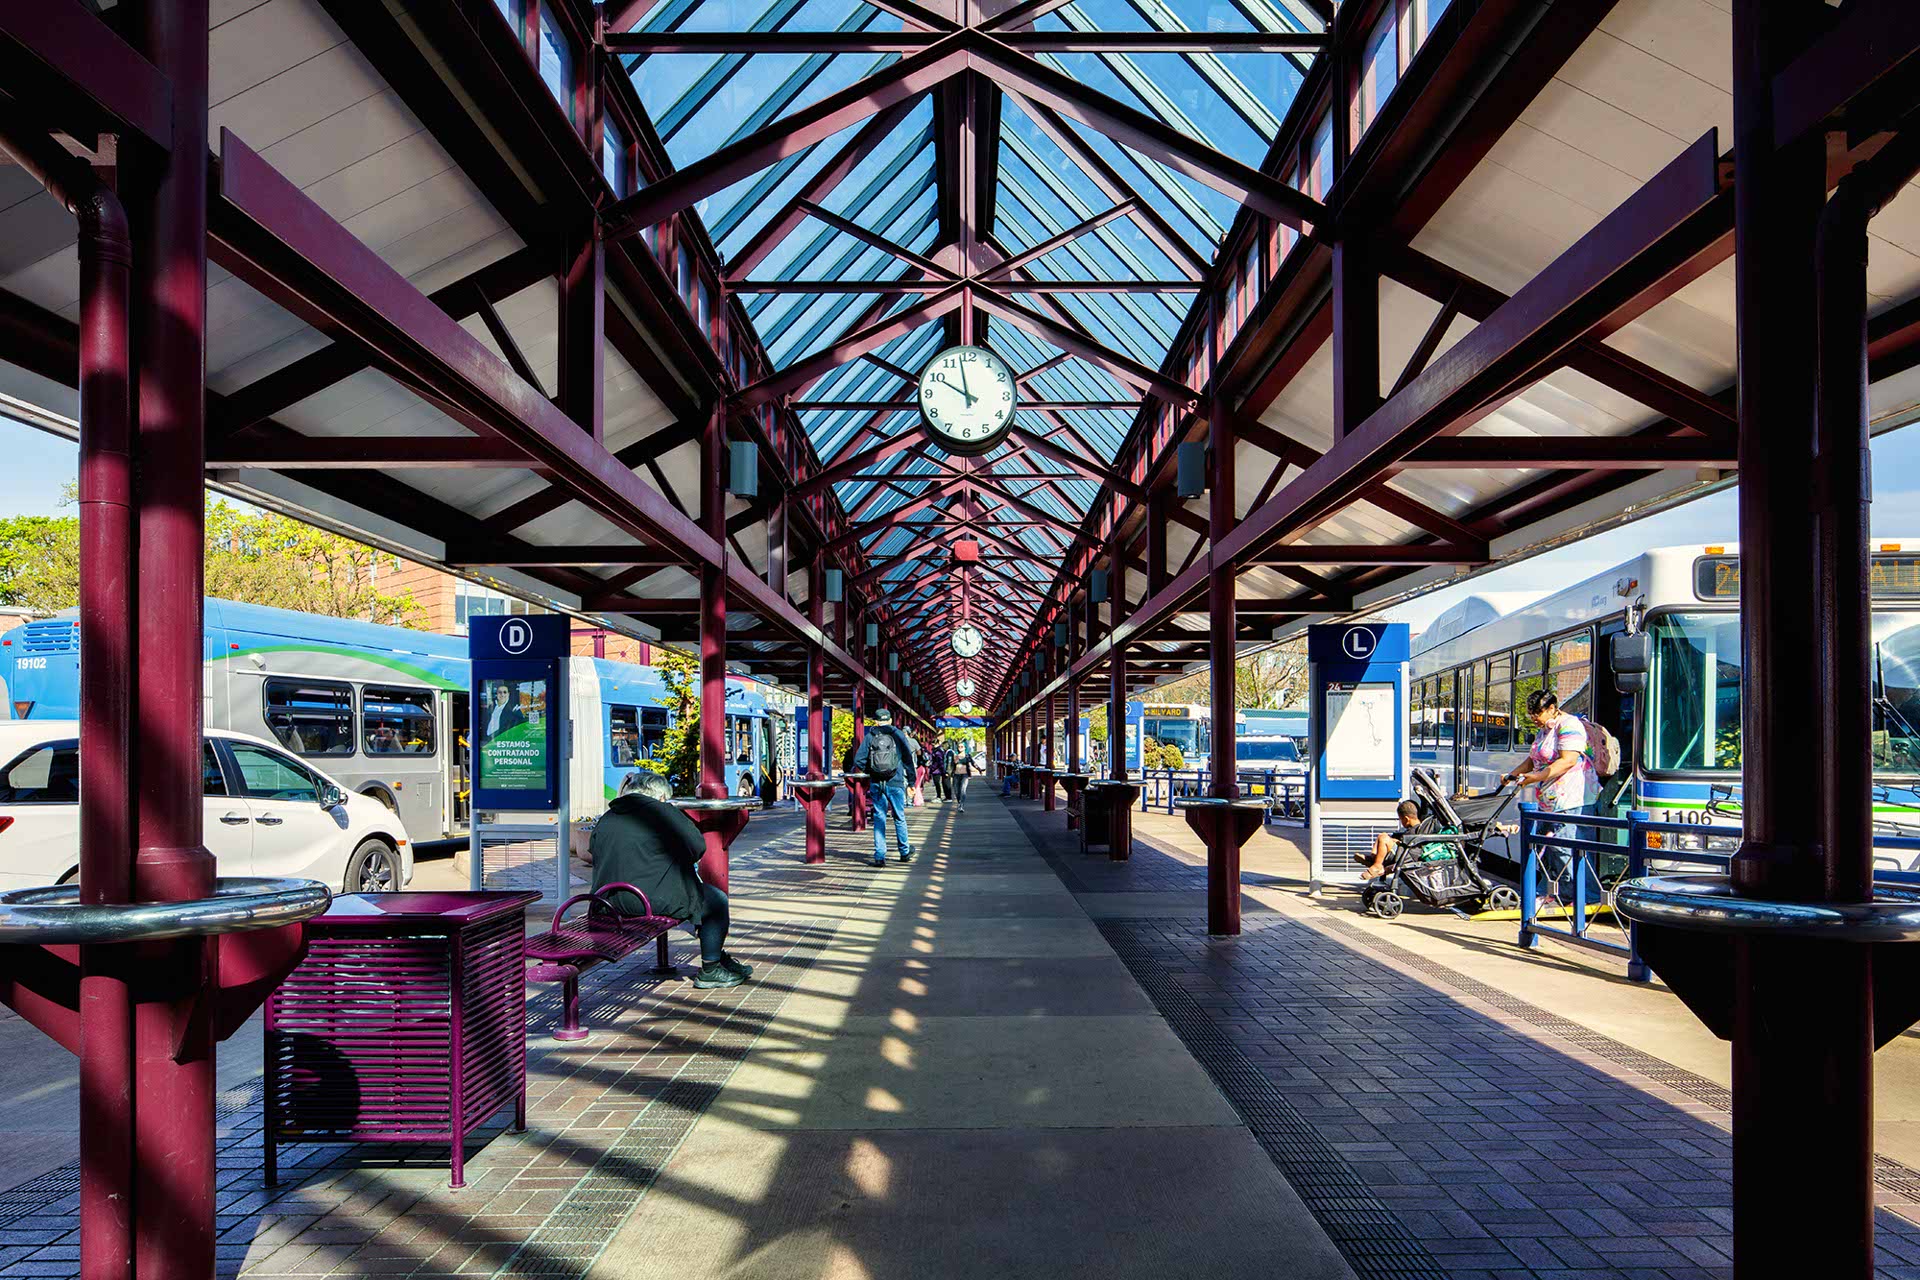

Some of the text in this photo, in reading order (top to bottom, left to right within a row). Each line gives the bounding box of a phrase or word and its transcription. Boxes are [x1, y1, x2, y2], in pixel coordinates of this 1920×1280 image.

[962, 352, 977, 362] 12
[943, 358, 956, 368] 11
[986, 358, 992, 368] 1
[930, 372, 945, 382] 10
[997, 372, 1006, 382] 2
[924, 389, 933, 398] 9
[1002, 392, 1010, 401] 3
[930, 408, 938, 418] 8
[994, 410, 1004, 420] 4
[944, 423, 952, 432] 7
[982, 424, 990, 434] 5
[962, 428, 970, 438] 6
[1715, 563, 1739, 595] 2
[510, 626, 524, 646] D
[1354, 633, 1367, 652] L
[16, 658, 46, 670] 19102
[1328, 683, 1340, 691] 24
[1662, 810, 1712, 825] 1106
